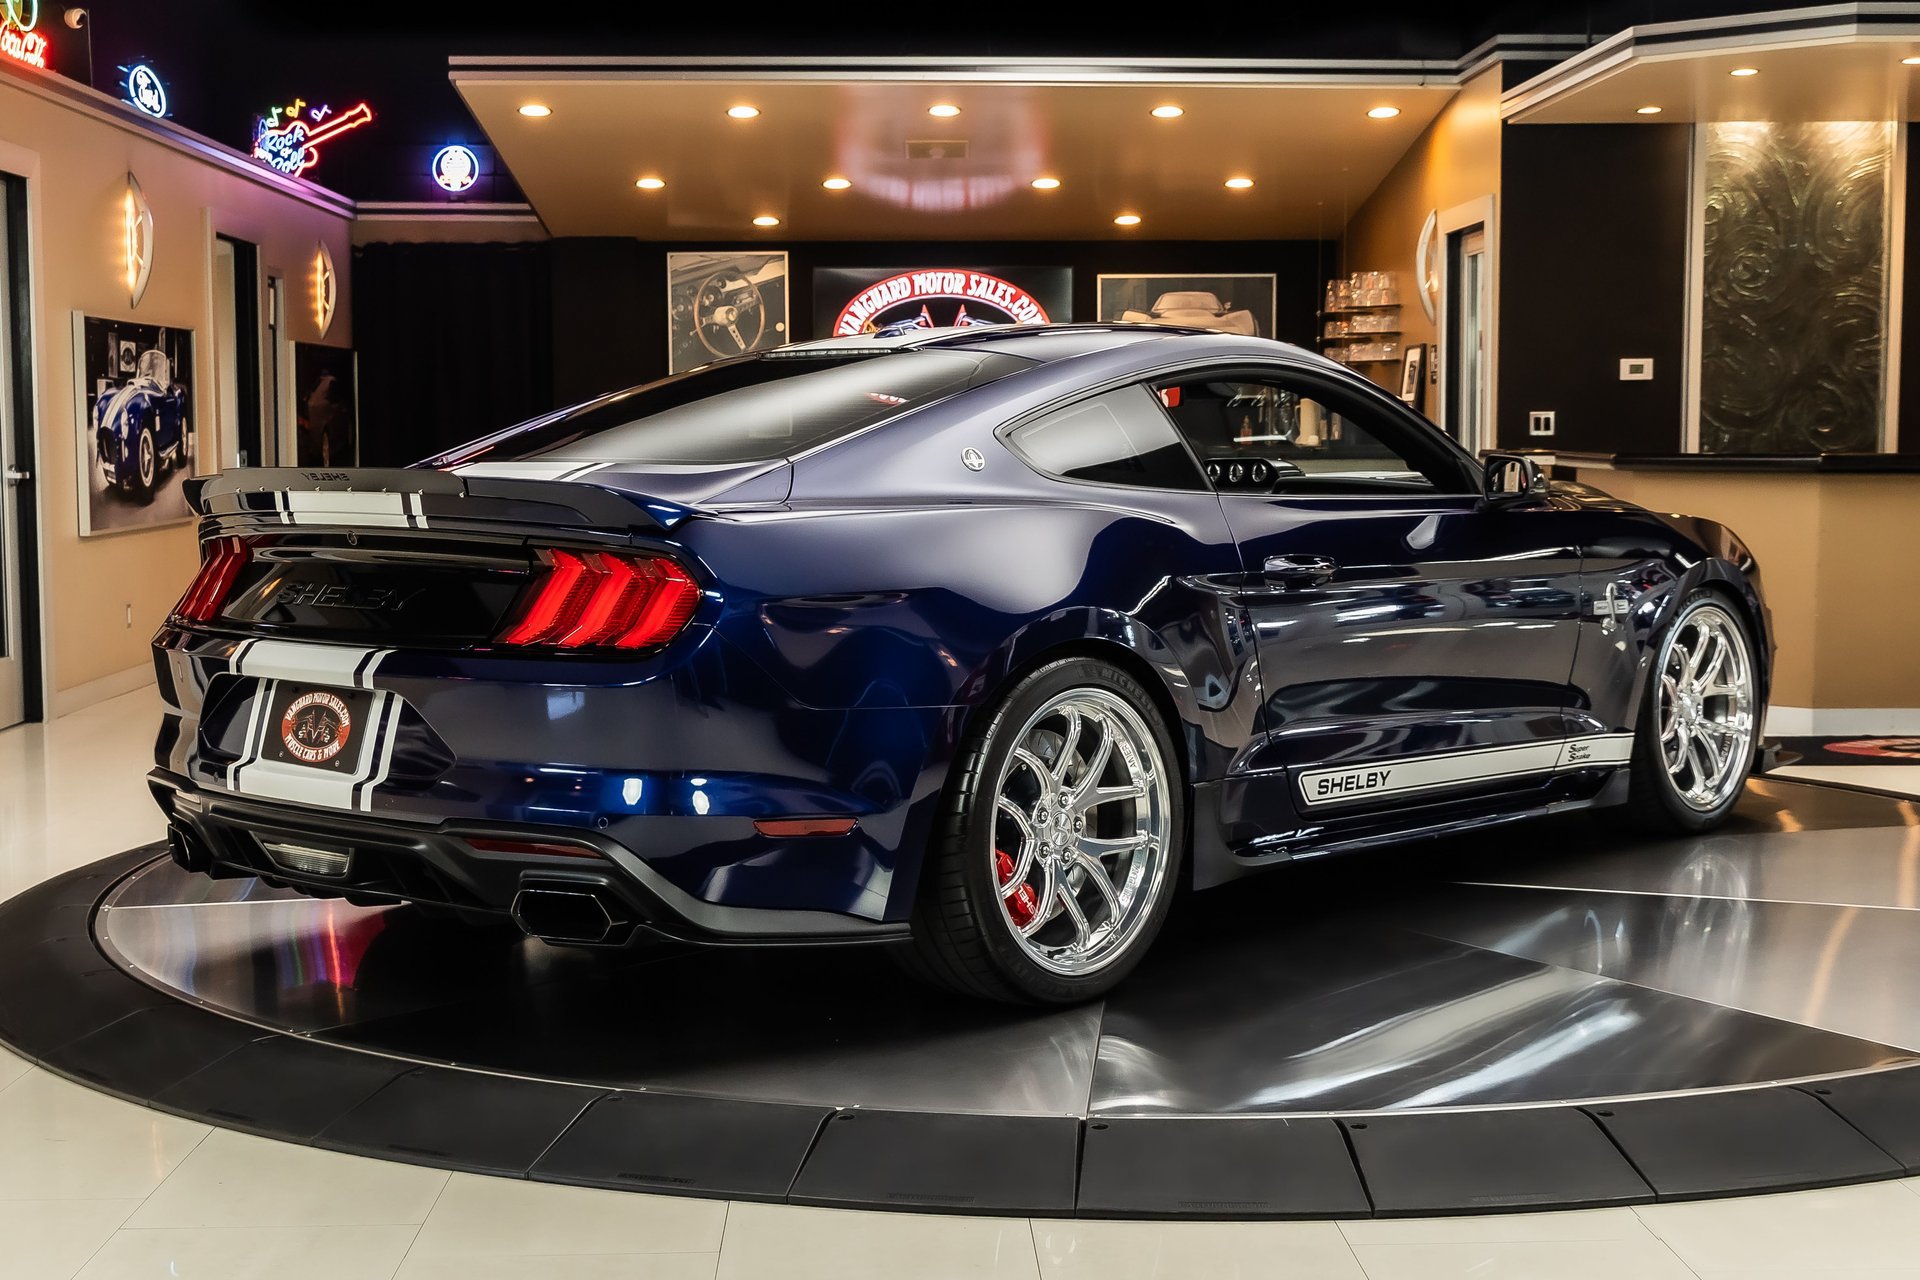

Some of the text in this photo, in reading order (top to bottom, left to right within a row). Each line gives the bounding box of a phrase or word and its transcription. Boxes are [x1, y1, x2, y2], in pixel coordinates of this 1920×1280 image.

[265, 125, 305, 152] Rock
[838, 277, 912, 335] VANGUARD
[912, 272, 966, 295] MOTOR
[1317, 770, 1391, 795] SHELBY
[1018, 885, 1037, 915] SHEL
